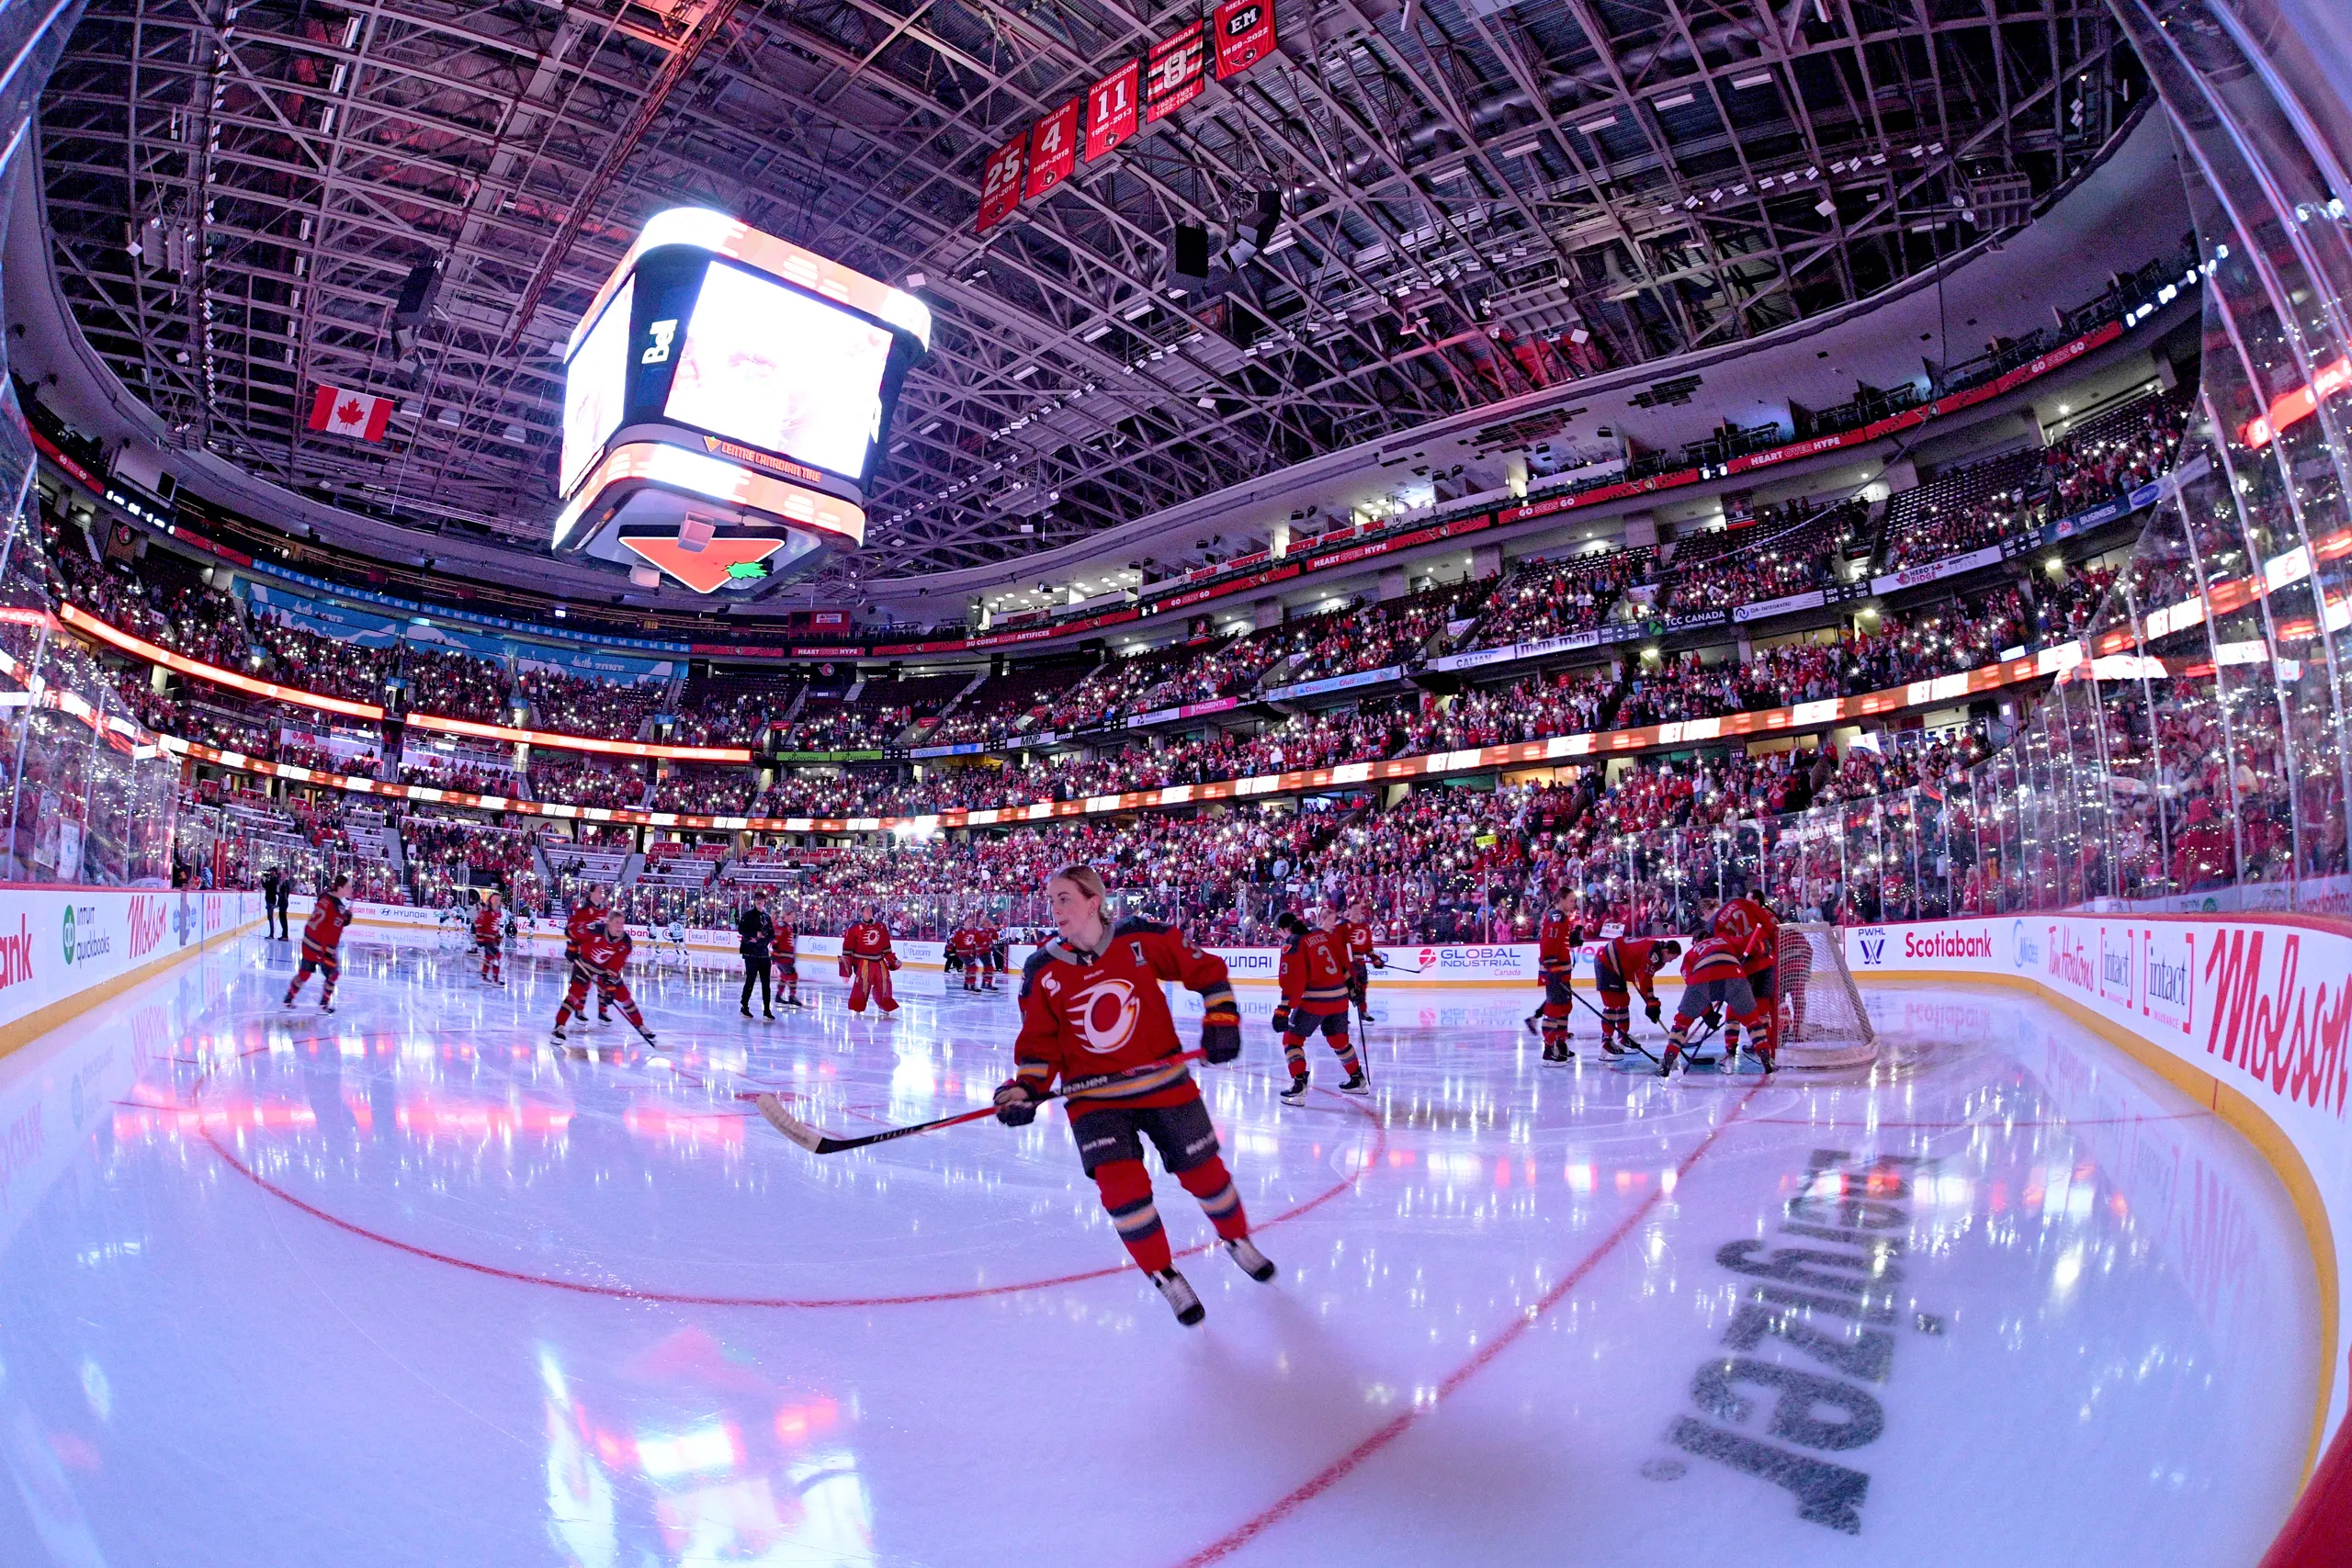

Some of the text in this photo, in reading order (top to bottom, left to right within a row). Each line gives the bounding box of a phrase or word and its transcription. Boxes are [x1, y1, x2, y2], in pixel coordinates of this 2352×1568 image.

[1231, 7, 1258, 34] EM
[1158, 28, 1194, 53] FINNIGAN
[1222, 27, 1269, 57] 1959-2022
[1090, 62, 1137, 96] ALFREDSSON
[1163, 50, 1187, 89] 8
[1097, 80, 1127, 123] 11
[1041, 106, 1071, 128] PHILLIPS
[1091, 107, 1133, 137] 1995-2013
[1041, 121, 1061, 152] 4
[984, 148, 1020, 197] 25
[1033, 148, 1069, 174] 1997-2015
[984, 182, 1016, 209] 2001-2017
[641, 319, 678, 364] Bell
[2031, 361, 2046, 373] GO
[2070, 342, 2085, 354] GO
[721, 442, 821, 483] CENTRE CANADIAN TIRE
[1751, 436, 1840, 466] HEART OVER HYPE
[1519, 497, 1575, 517] GO SENS GO
[2079, 505, 2117, 525] BUSINESS
[1314, 543, 1387, 568] HEART OVER HYPE
[1910, 566, 1935, 578] HERO'S
[1911, 572, 1936, 583] RIDGE
[1170, 598, 1182, 606] GO
[1664, 611, 1725, 626] TCC CANADA
[977, 637, 998, 646] COEUR
[1017, 630, 1049, 640] ARTIFICES
[1456, 654, 1492, 669] CALIAN
[1305, 683, 1322, 693] Coors
[1339, 677, 1356, 686] Chill
[1195, 700, 1227, 711] MAGENTA
[1020, 736, 1041, 746] MNP
[128, 895, 167, 959] Molson
[394, 909, 427, 919] HYUNDAI
[692, 931, 706, 942] intact
[1859, 928, 1885, 937] PWHL
[1905, 929, 1992, 957] Scotiabank
[77, 930, 110, 969] quickbooks
[1317, 945, 1338, 975] 3
[1441, 949, 1521, 959] GLOBAL
[2048, 925, 2095, 992] Tim Hortons
[1281, 963, 1288, 975] 3
[1441, 958, 1521, 968] INDUSTRIAL
[2104, 941, 2129, 987] intact
[2149, 947, 2187, 1006] intact
[2153, 1011, 2179, 1030] INSURANCE
[2205, 928, 2352, 1122] Molson
